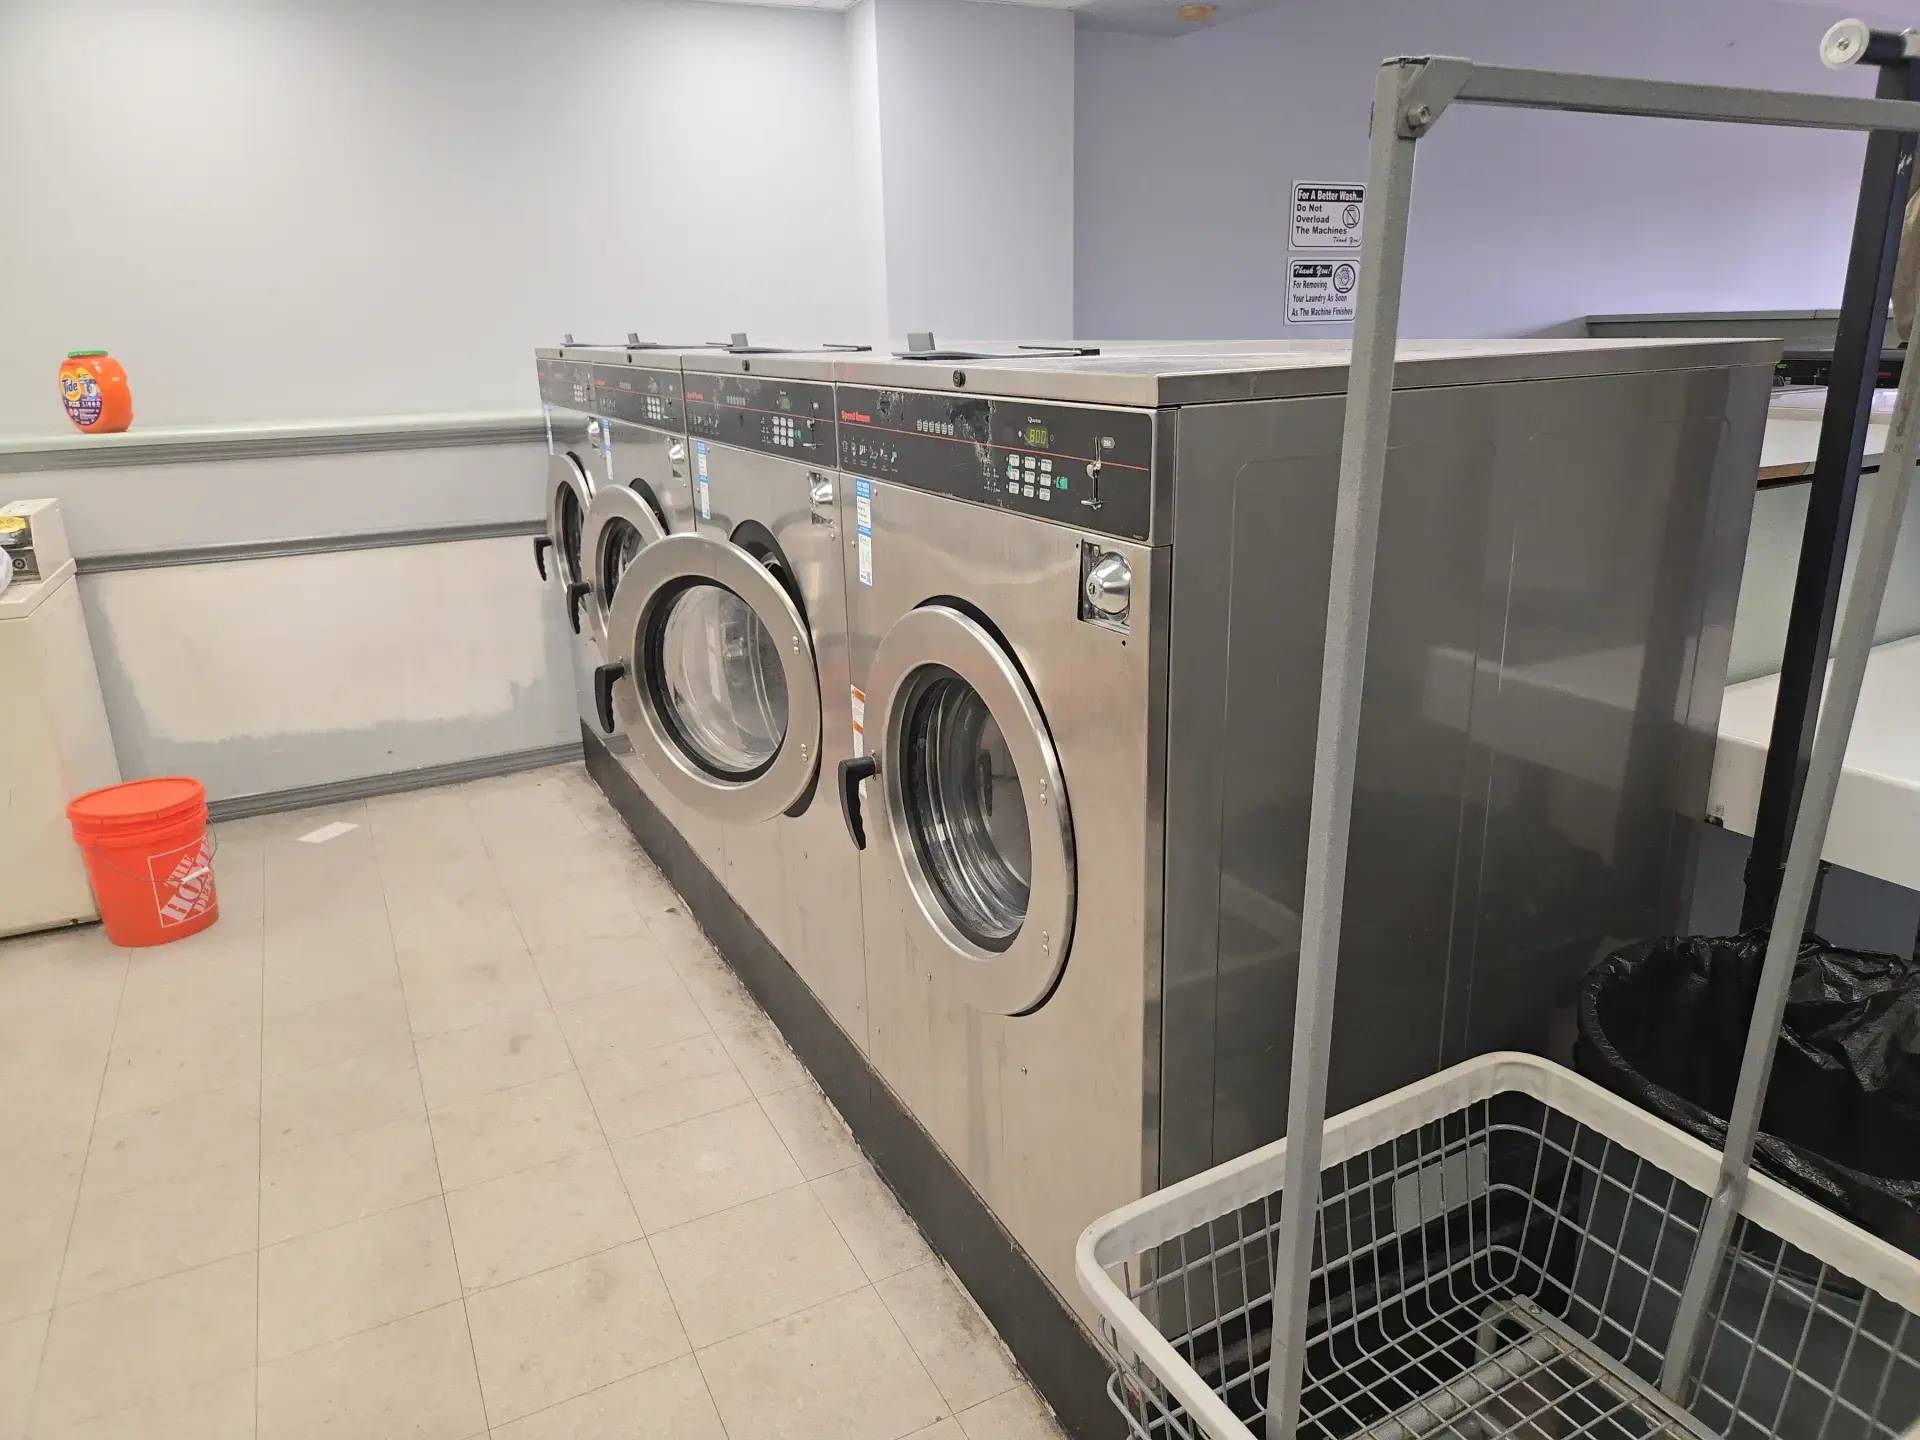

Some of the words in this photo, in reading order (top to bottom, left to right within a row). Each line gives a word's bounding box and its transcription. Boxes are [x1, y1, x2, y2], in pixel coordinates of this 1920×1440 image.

[1298, 189, 1310, 199] For
[1310, 190, 1316, 200] A
[1318, 190, 1338, 200] Better
[1296, 204, 1306, 212] Do
[1309, 204, 1322, 212] Not
[1296, 215, 1330, 223] Overload
[1296, 226, 1310, 234] The
[1312, 226, 1348, 235] Machines
[1294, 266, 1314, 275] Thank
[1316, 266, 1332, 277] You!
[1293, 280, 1302, 288] For
[1303, 280, 1327, 291] Removing
[1293, 294, 1304, 303] Your
[1306, 294, 1326, 304] Laundry
[1327, 294, 1333, 302] As
[1335, 294, 1347, 302] Soon
[1292, 308, 1298, 316] As
[1300, 308, 1309, 316] The
[1311, 308, 1331, 316] Machine
[1332, 307, 1353, 316] Finishes
[62, 379, 78, 395] Tide
[164, 854, 195, 888] THE
